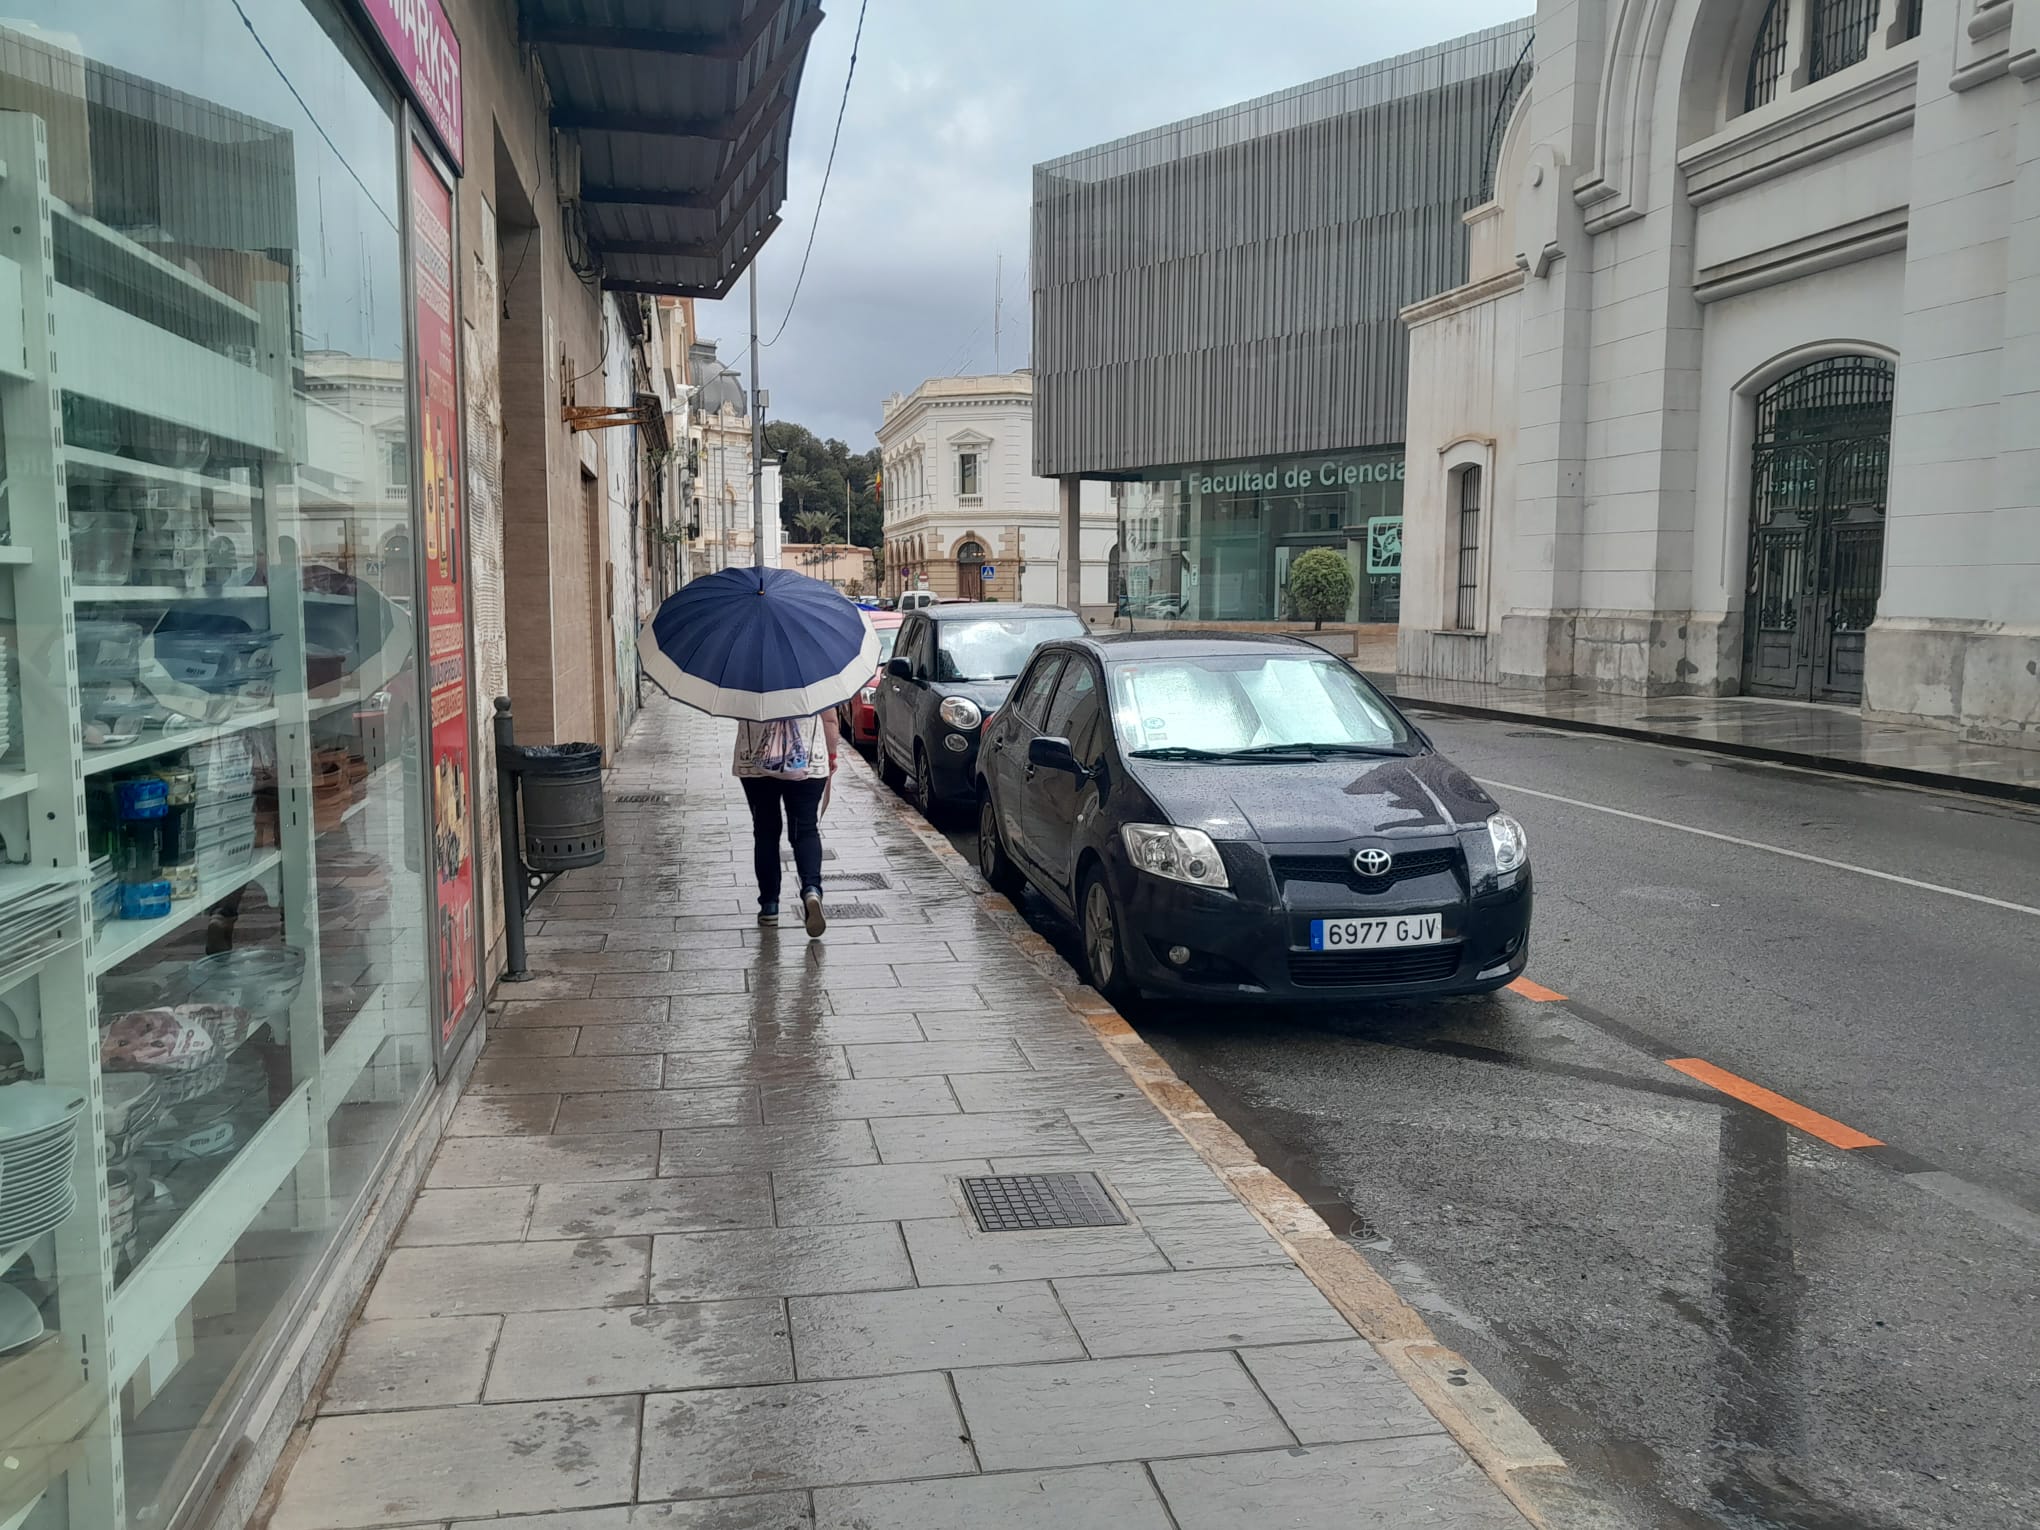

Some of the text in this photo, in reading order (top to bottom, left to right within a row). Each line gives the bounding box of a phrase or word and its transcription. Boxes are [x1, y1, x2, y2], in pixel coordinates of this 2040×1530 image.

[389, 0, 458, 128] ARKET
[1188, 464, 1278, 494] Facultad
[1284, 464, 1312, 489] de
[1329, 921, 1388, 945] 6977
[1396, 917, 1436, 942] GJV
